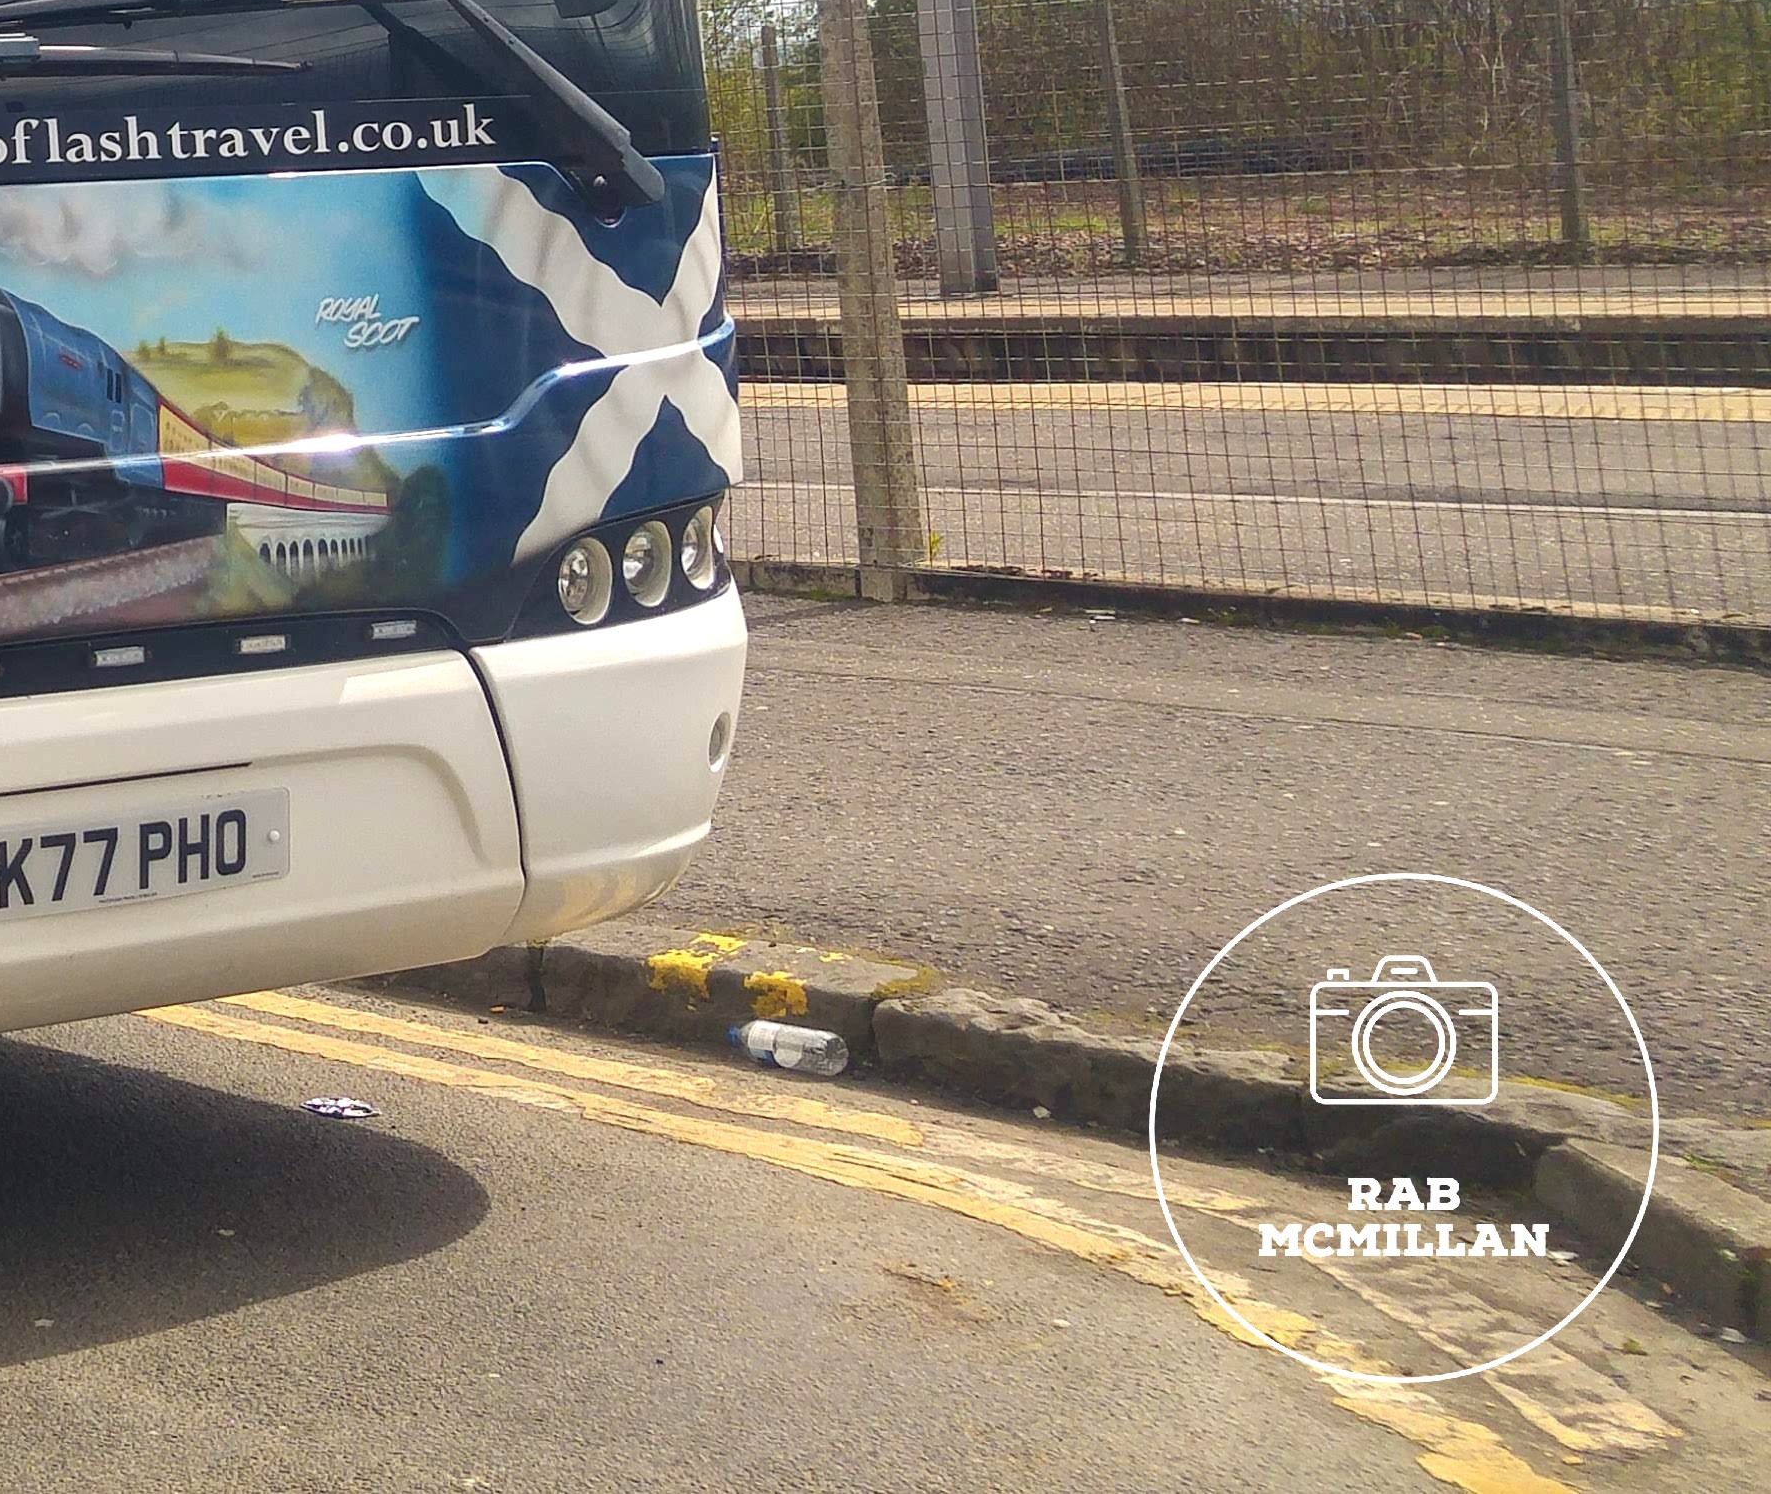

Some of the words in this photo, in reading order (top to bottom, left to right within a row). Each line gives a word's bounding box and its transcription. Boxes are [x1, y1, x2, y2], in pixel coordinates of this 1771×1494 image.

[315, 293, 381, 324] ROYAL
[344, 316, 420, 347] SCOT
[139, 809, 246, 890] PHO
